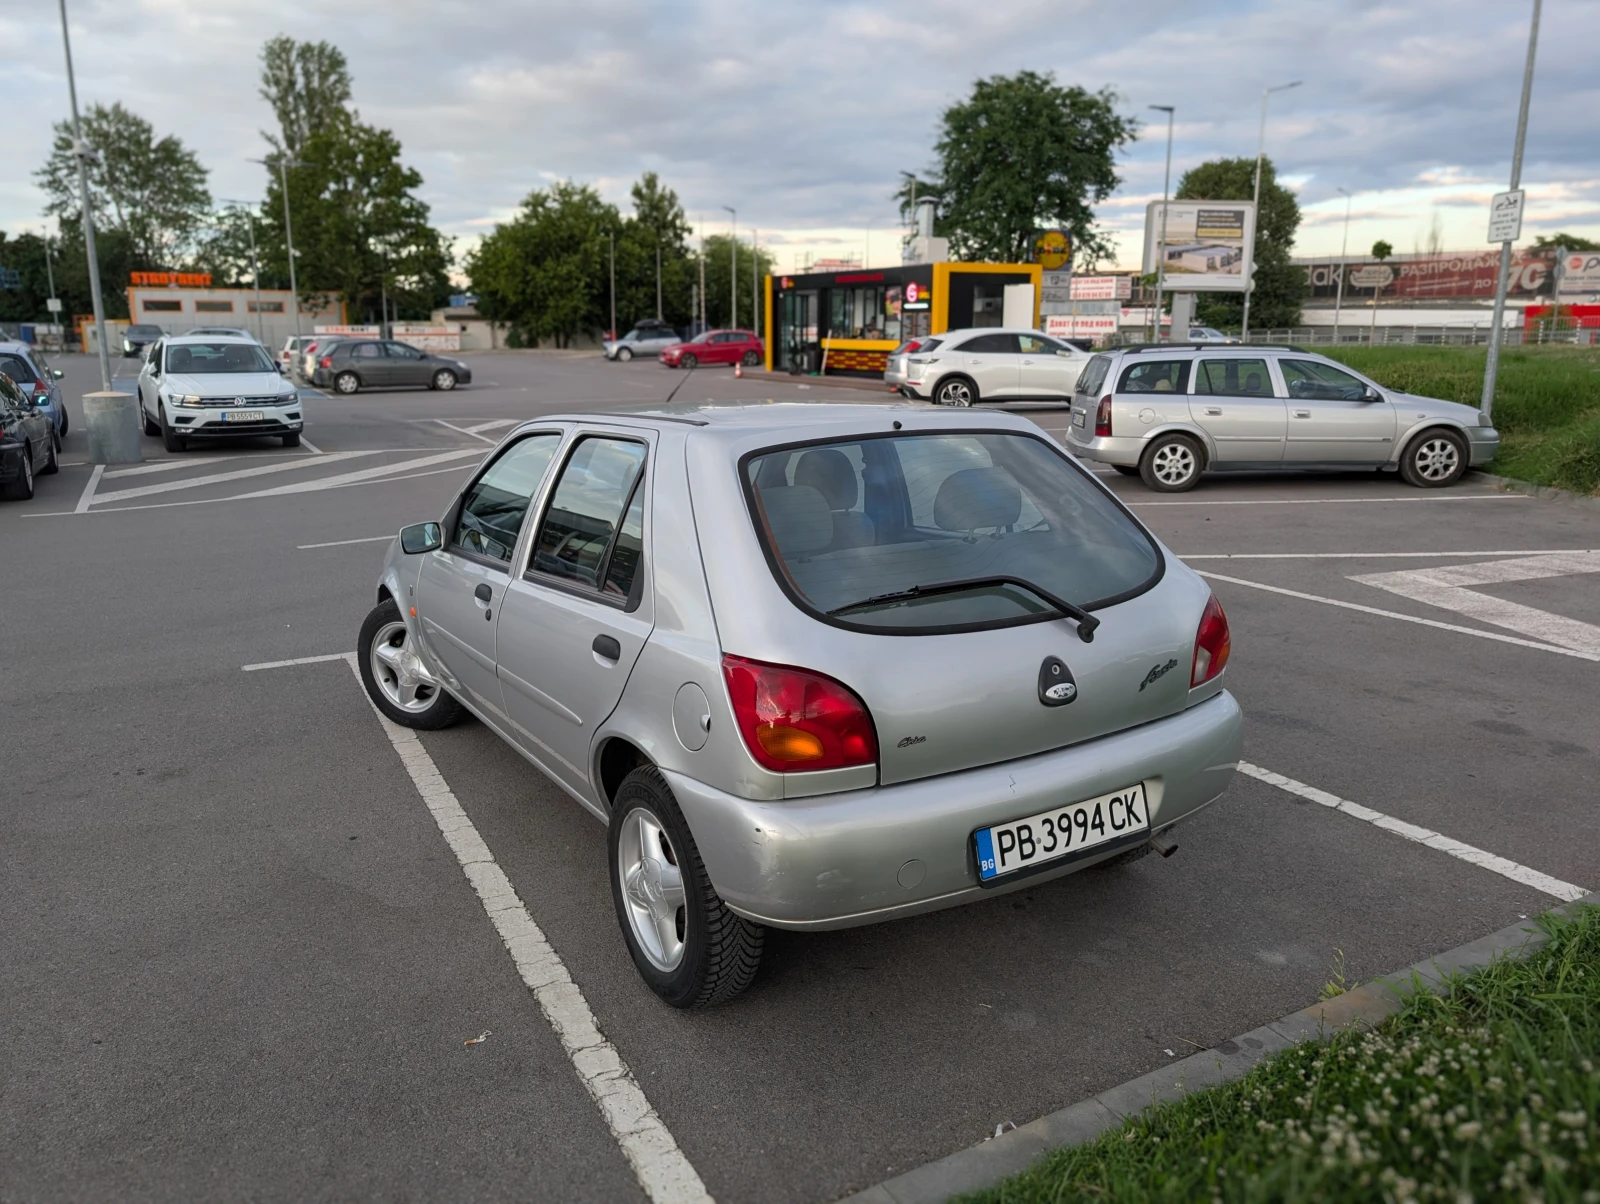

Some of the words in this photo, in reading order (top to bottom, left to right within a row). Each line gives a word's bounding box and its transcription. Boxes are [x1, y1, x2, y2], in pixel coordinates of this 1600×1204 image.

[981, 858, 995, 872] BG
[1041, 802, 1105, 853] 3994
[1108, 791, 1143, 831] CK
